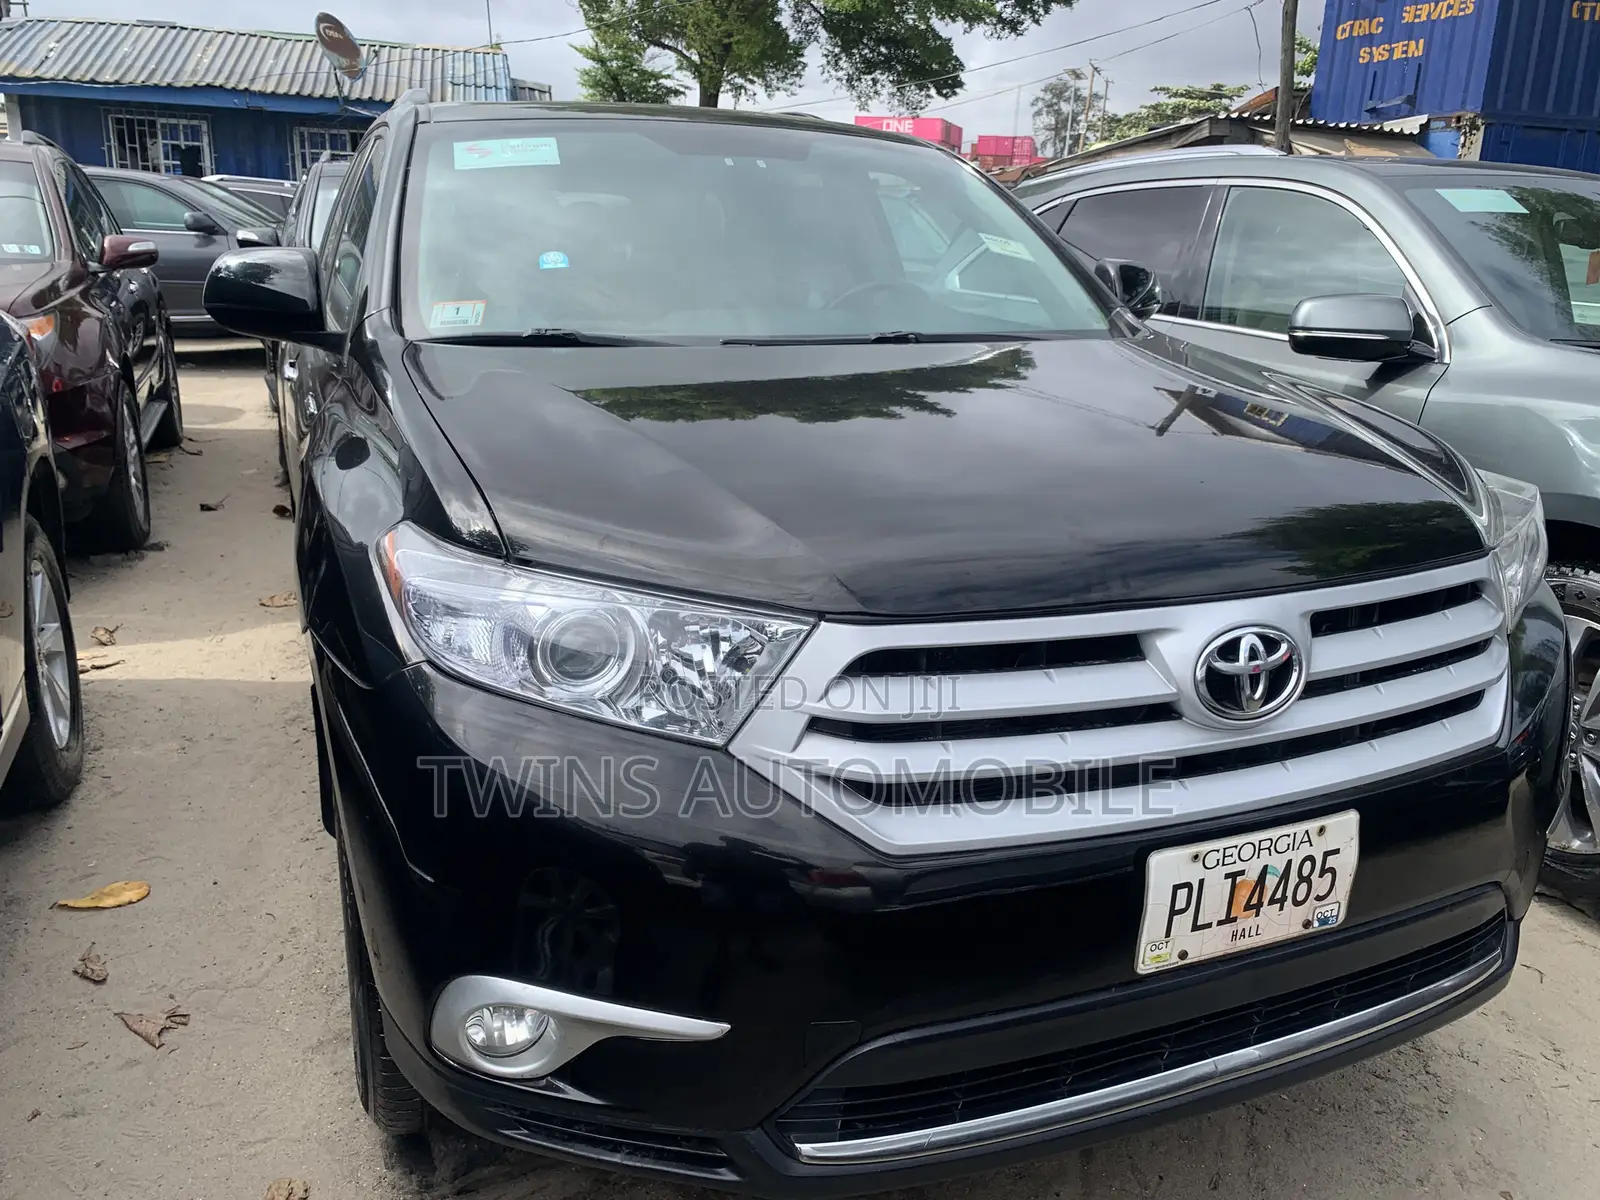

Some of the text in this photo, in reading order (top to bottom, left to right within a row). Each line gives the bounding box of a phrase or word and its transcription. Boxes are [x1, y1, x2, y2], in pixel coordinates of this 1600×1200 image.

[1358, 38, 1425, 64] SYSTEM
[882, 119, 914, 133] ONE
[1201, 829, 1314, 870] GEORGIA
[1316, 908, 1335, 920] OCT
[1230, 924, 1262, 942] HALL
[1149, 940, 1171, 952] OCT
